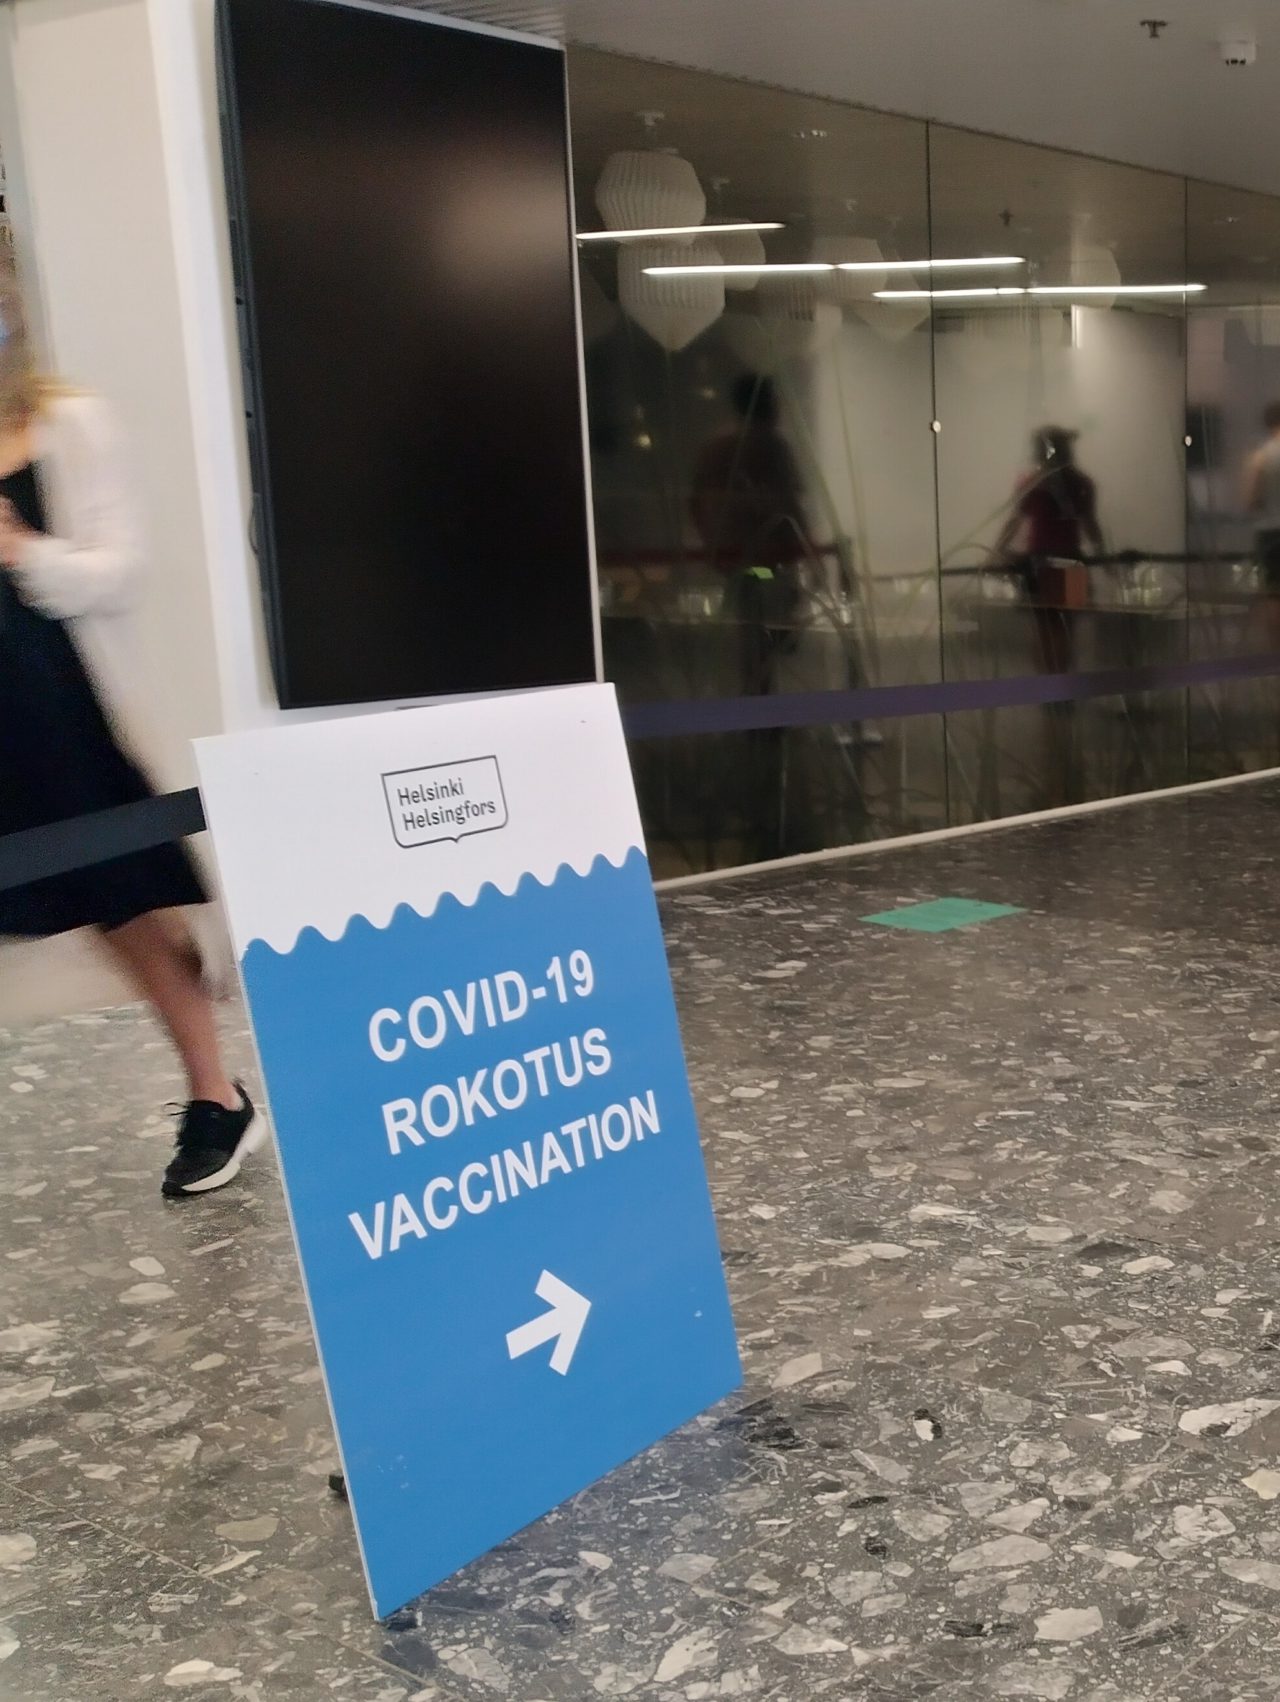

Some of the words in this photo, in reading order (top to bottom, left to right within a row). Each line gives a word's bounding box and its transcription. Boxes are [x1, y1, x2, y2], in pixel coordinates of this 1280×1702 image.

[397, 777, 464, 807] Helsinki
[402, 800, 496, 831] Helsingfors
[368, 949, 594, 1062] COVID-19
[381, 1027, 612, 1155] ROKOTUS
[348, 1089, 661, 1260] VACCINATION
